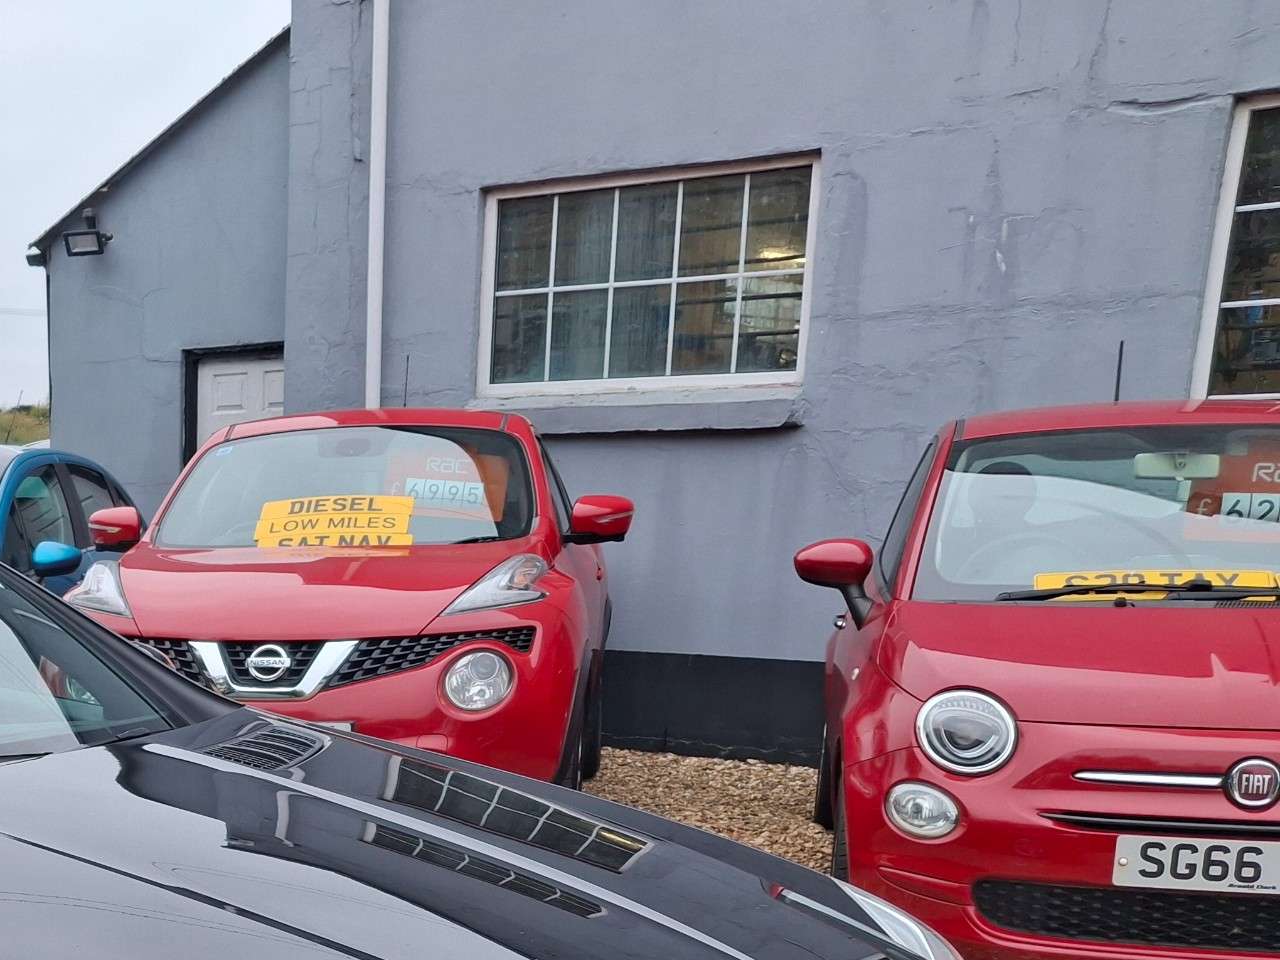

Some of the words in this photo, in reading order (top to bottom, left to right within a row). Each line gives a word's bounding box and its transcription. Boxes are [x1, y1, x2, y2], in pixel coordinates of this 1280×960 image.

[287, 497, 384, 515] DIESEL
[269, 518, 320, 534] LOW
[327, 516, 397, 529] MILES
[277, 535, 330, 547] SAT
[337, 534, 393, 546] NAV
[1240, 773, 1272, 795] FIAT
[1137, 841, 1265, 884] SG66
